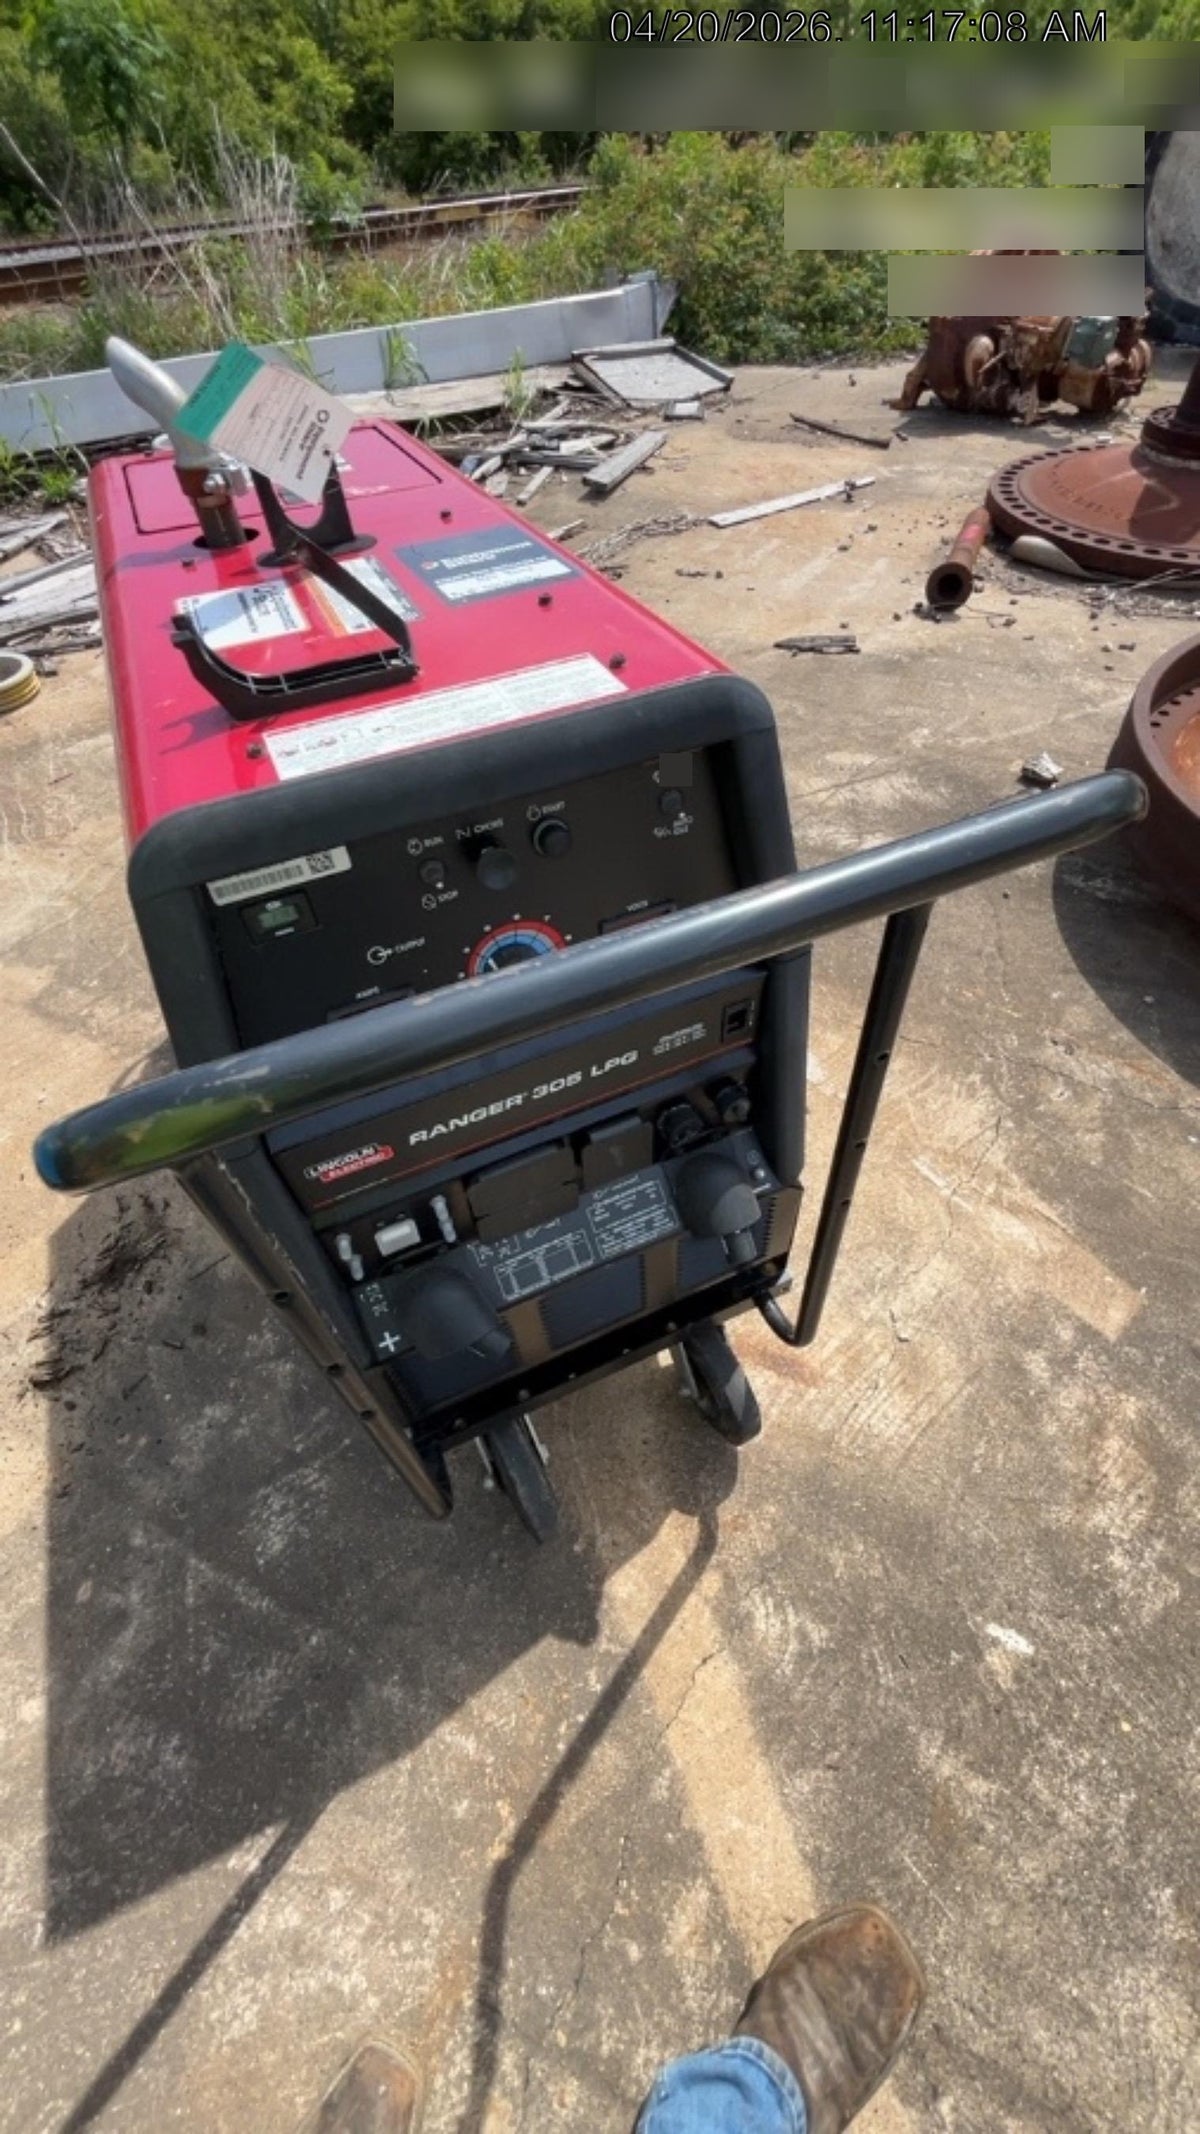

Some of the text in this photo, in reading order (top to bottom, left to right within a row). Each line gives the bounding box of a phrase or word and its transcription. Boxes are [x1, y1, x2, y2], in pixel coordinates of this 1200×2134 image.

[531, 1071, 582, 1099] 305
[591, 1050, 639, 1078] LPG
[307, 1144, 377, 1178] LINCOLN
